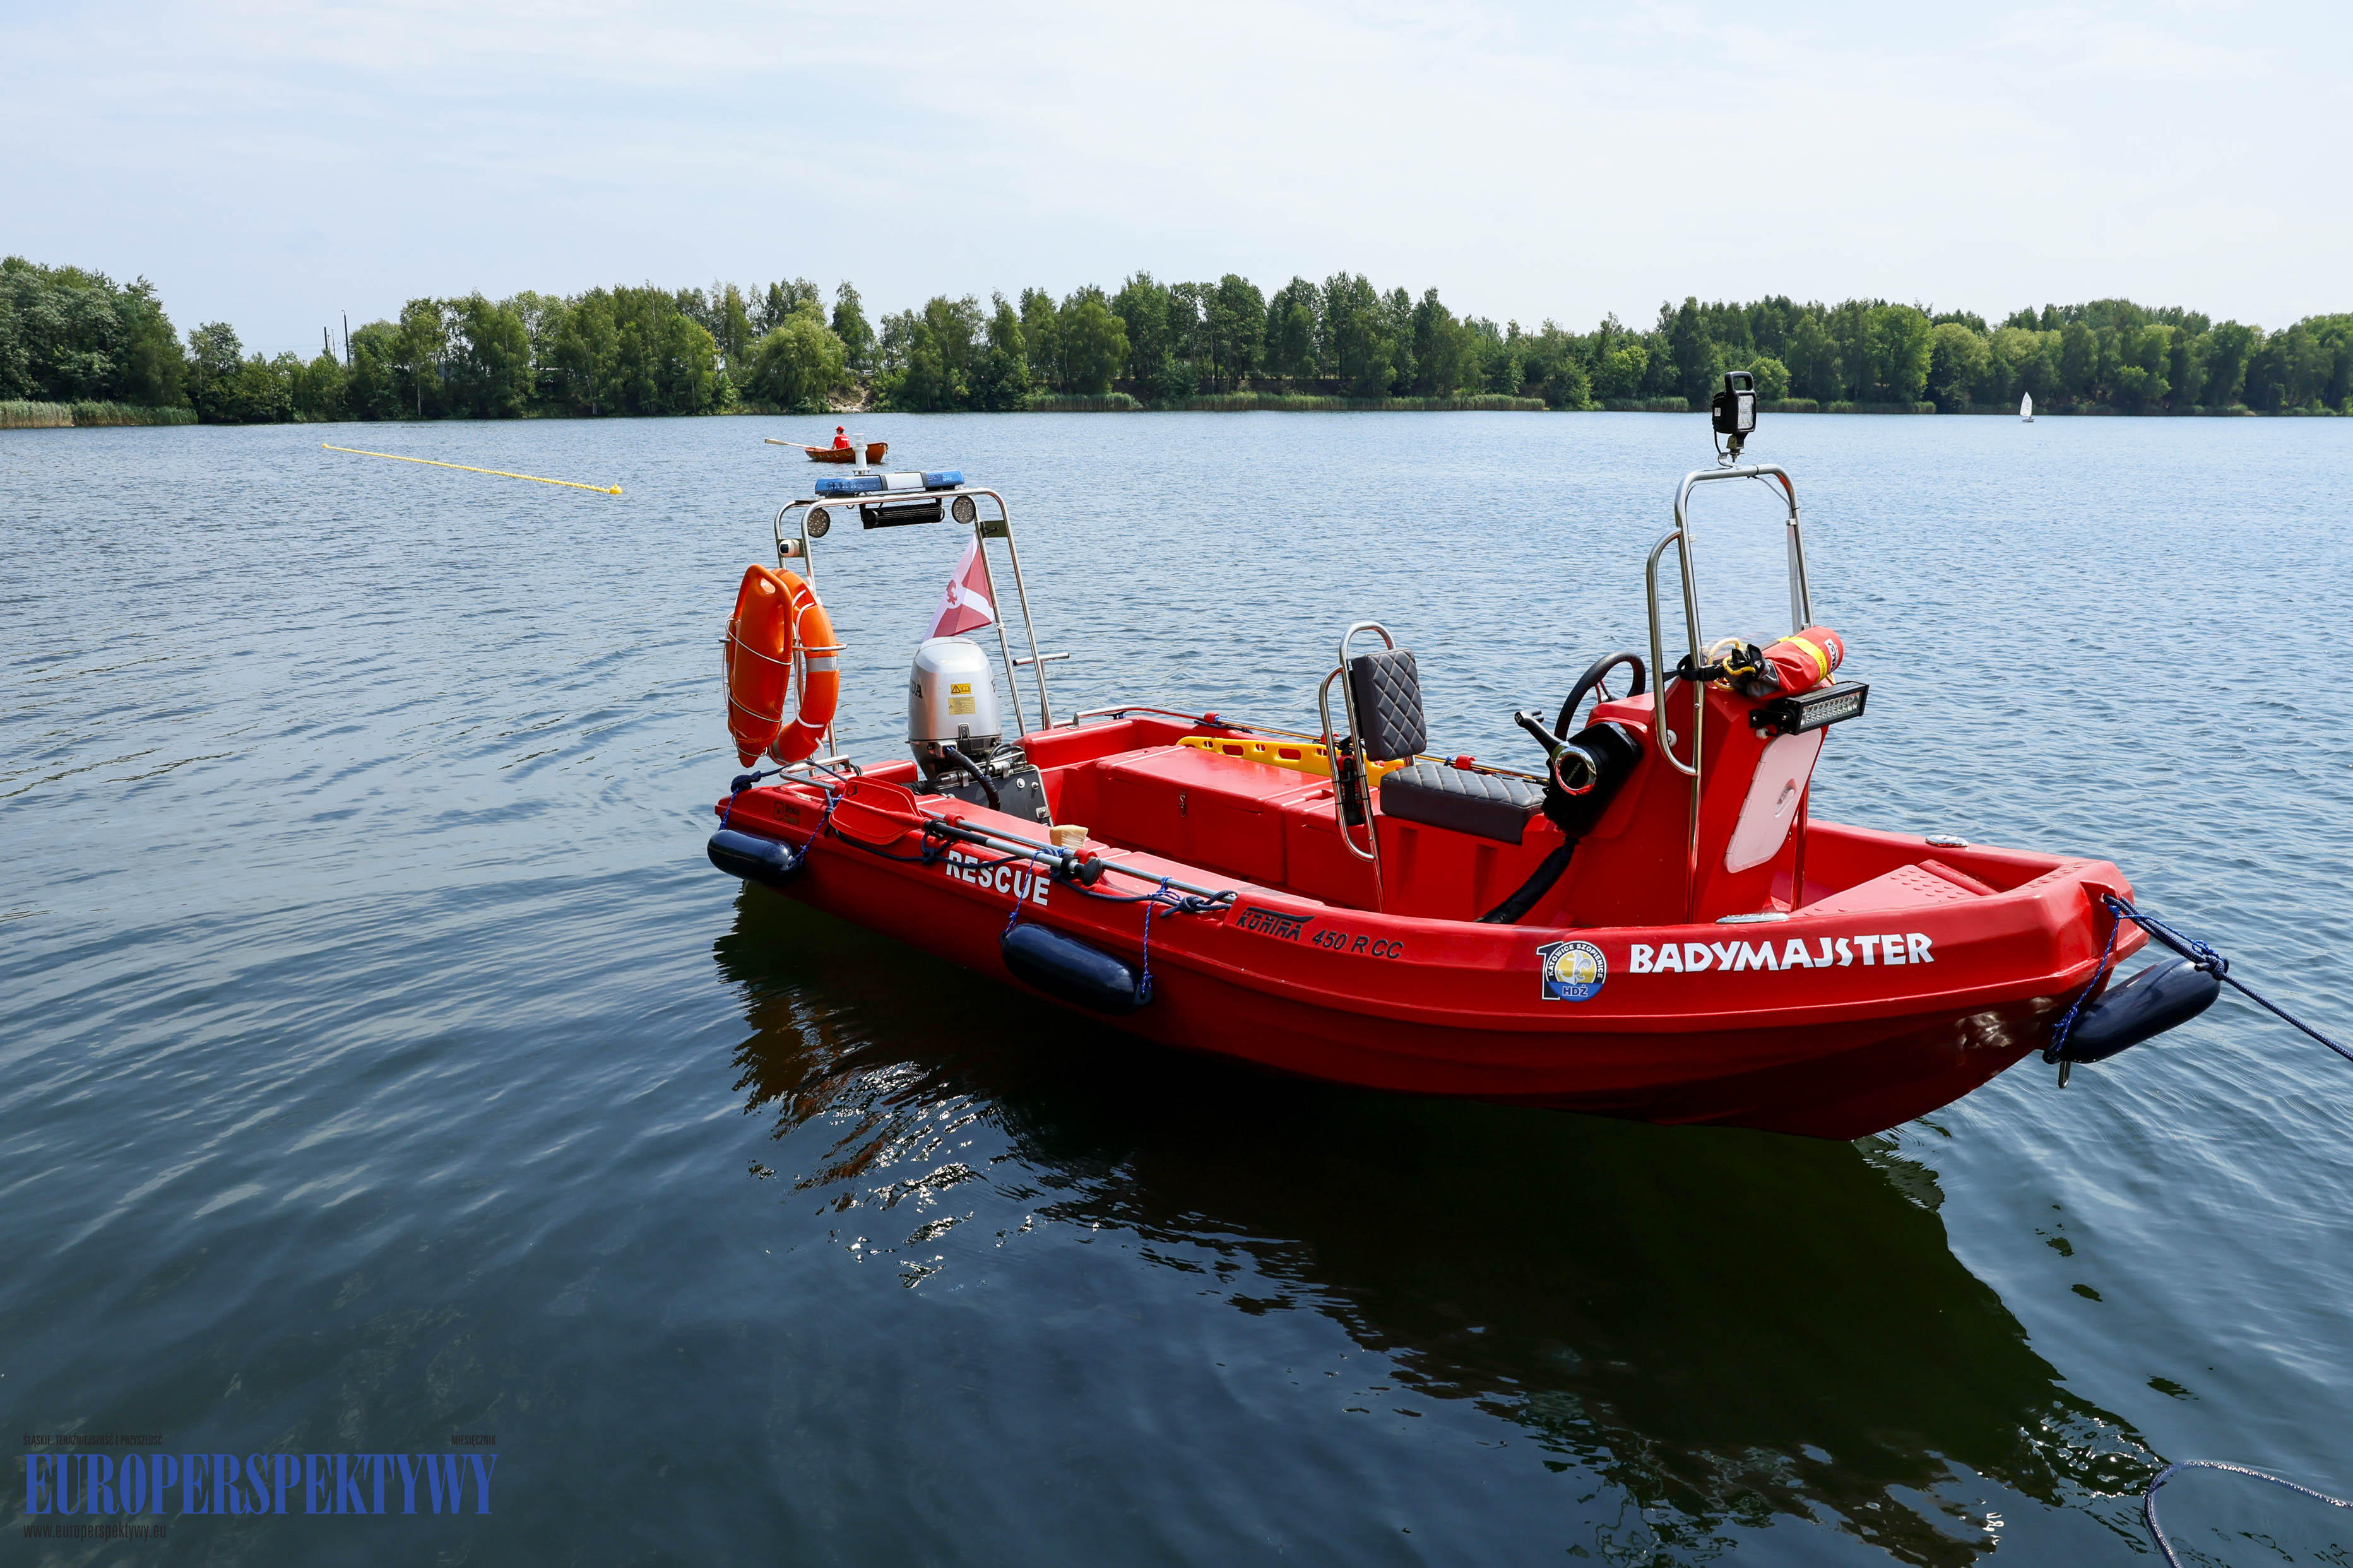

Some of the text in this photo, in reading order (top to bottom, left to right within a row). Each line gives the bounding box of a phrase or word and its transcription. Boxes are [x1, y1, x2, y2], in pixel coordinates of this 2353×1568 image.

[946, 850, 1051, 906] RESCUE
[1236, 907, 1315, 941] KONTRA
[1312, 929, 1348, 950] 450
[1548, 944, 1574, 977] KATOWICE
[1576, 943, 1603, 979] SZOPIENICE
[1629, 933, 1935, 974] BADYMAJSTER
[1562, 984, 1588, 997] HDŻ
